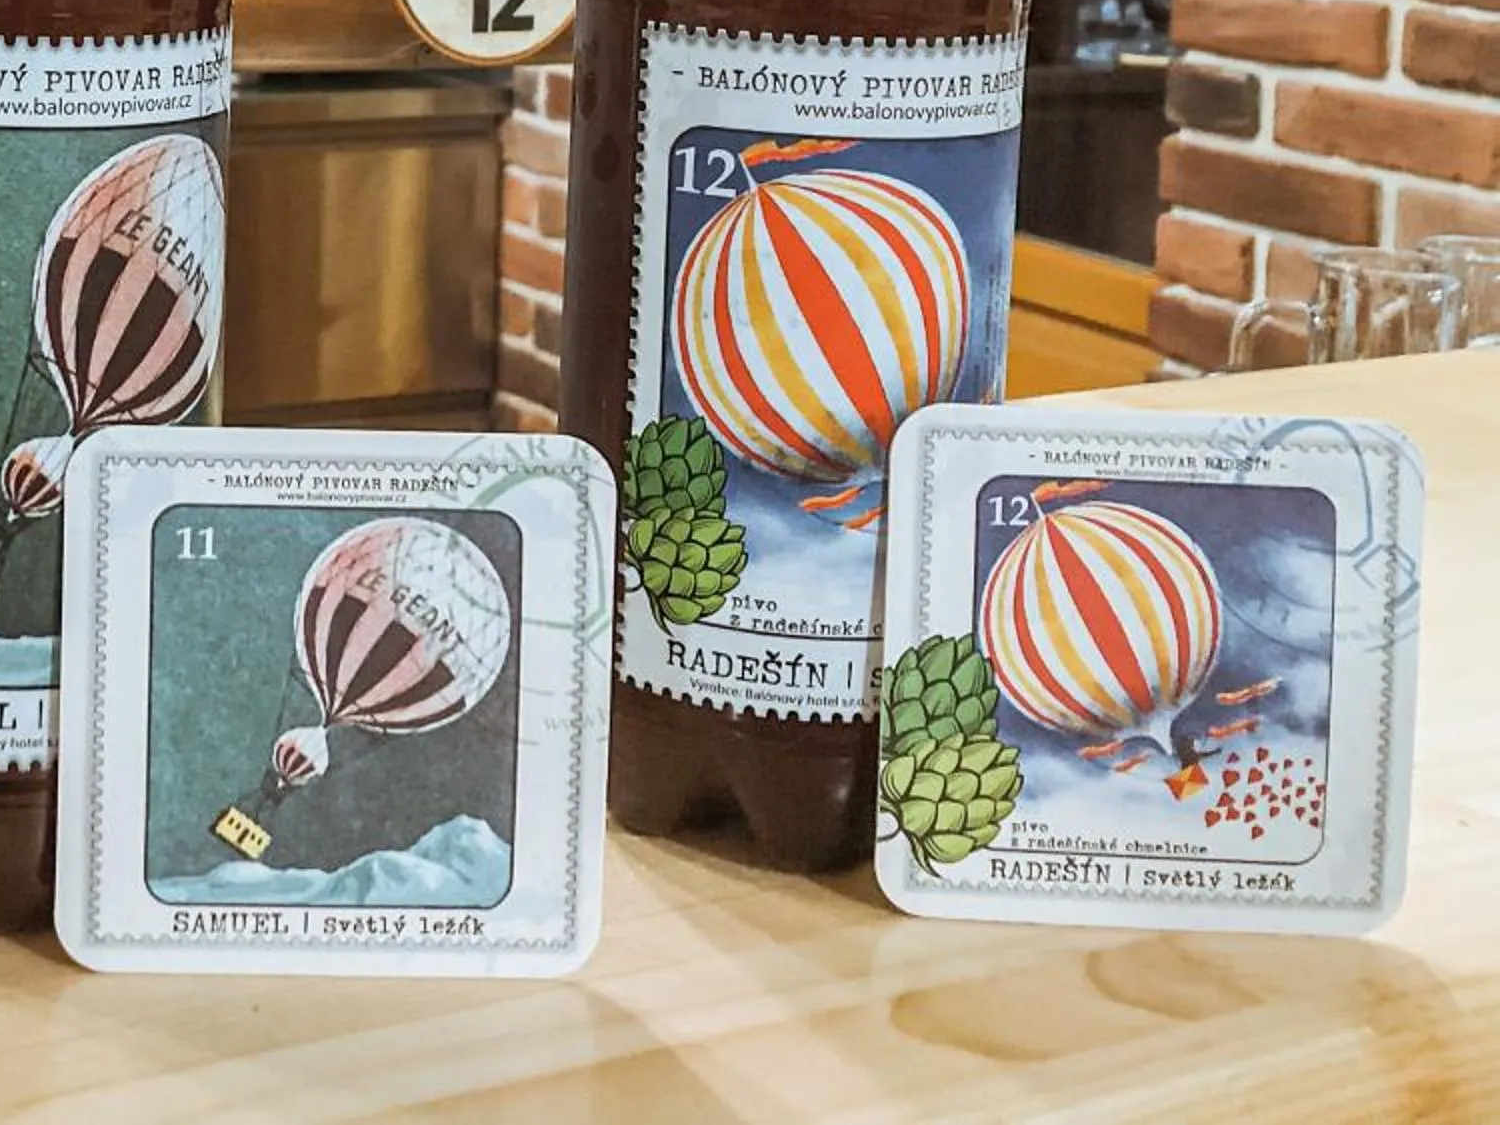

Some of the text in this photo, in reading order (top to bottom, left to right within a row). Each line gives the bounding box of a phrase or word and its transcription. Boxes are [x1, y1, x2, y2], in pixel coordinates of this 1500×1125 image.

[44, 68, 161, 93] PIVOVAR
[173, 48, 226, 87] RADEŠ
[699, 66, 847, 98] BALÓNOVÝ
[863, 75, 972, 98] PIVOVAR
[794, 102, 997, 124] www.balonovypivovar.cz
[674, 145, 739, 198] 12
[114, 208, 152, 241] LE
[1129, 454, 1197, 469] PIVOVAR
[224, 473, 304, 489] BALÓNOVÝ
[313, 476, 382, 491] PIVOVAR
[987, 496, 1030, 526] 12
[175, 527, 219, 560] 11
[731, 595, 777, 612] pivo
[752, 618, 865, 636] radešínské
[667, 638, 828, 690] RADEŠÍN
[806, 693, 839, 707] hotel
[1011, 821, 1049, 833] pivo
[1125, 841, 1208, 854] chmelnice
[990, 856, 1111, 884] RADEŠÍN
[1143, 869, 1221, 889] Světlý
[1233, 872, 1295, 892] ležák
[172, 911, 289, 935] SAMUEL
[323, 915, 405, 939] Světlý
[419, 915, 486, 935] ležák
